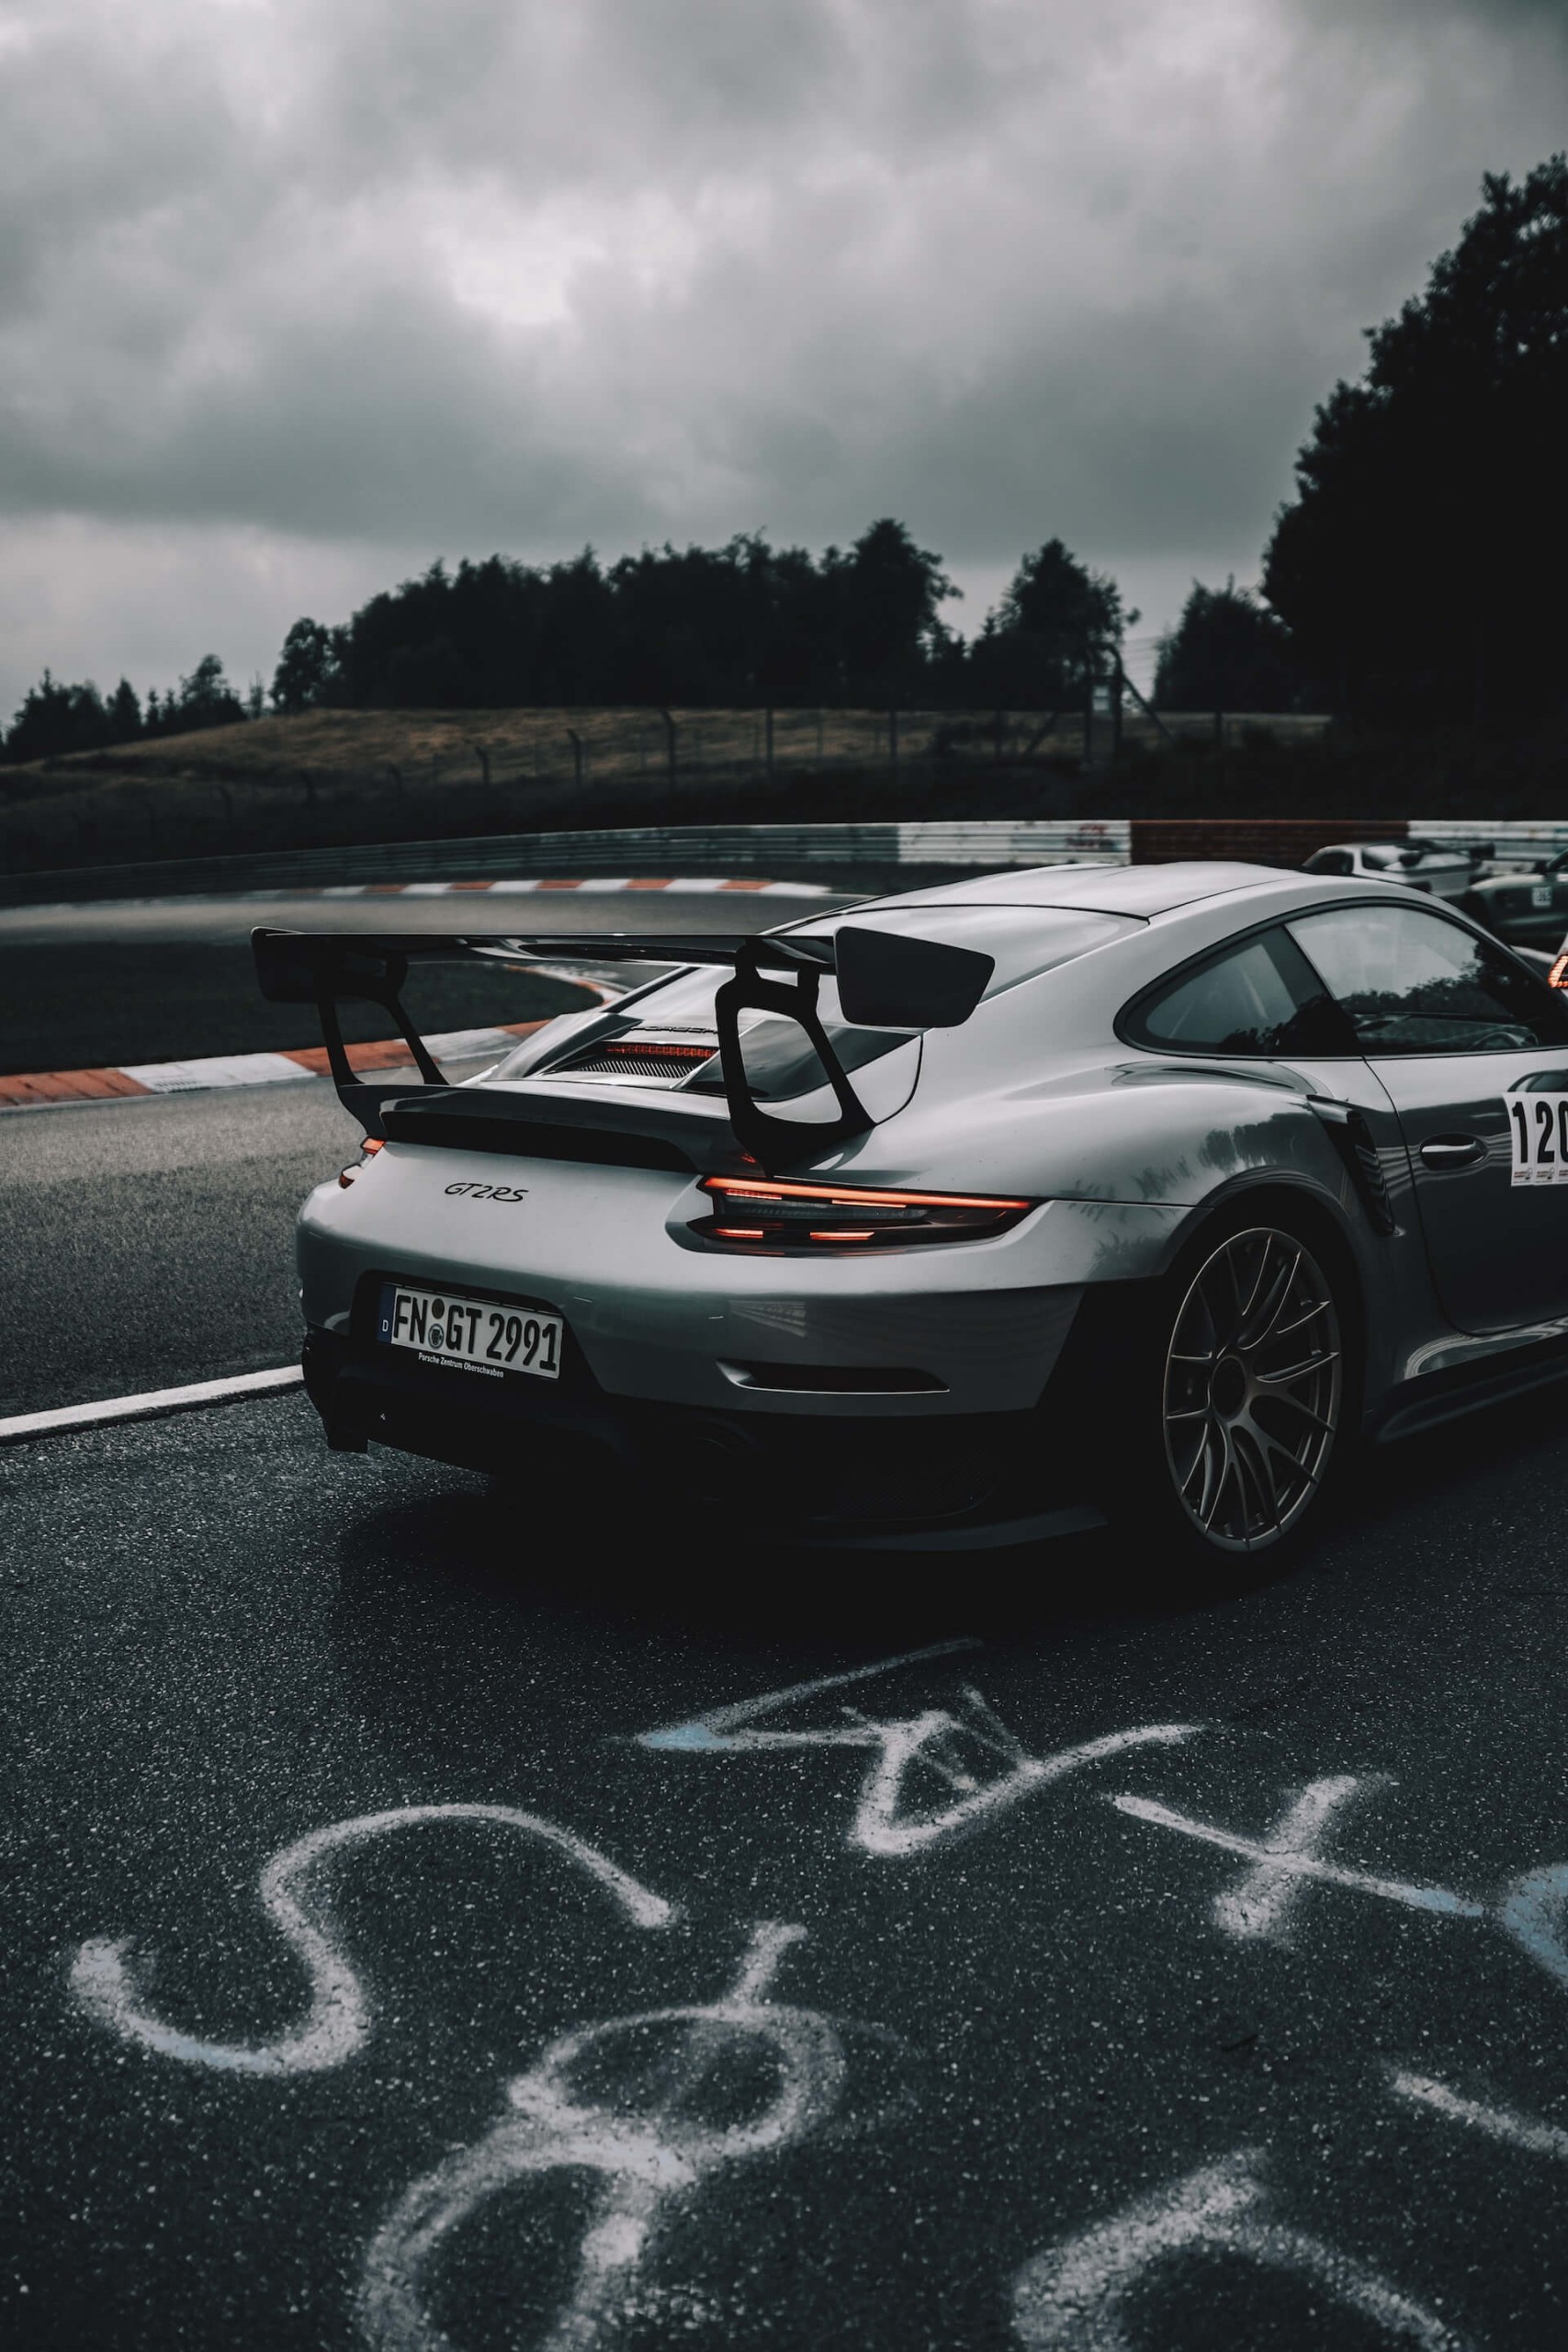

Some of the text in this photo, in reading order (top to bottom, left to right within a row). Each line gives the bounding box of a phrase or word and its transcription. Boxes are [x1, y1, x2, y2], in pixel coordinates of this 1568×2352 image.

[382, 1319, 389, 1331] D
[393, 1295, 558, 1372] FN GT 2991
[418, 1352, 504, 1378] Porsche Zentrum Oberschwaben
